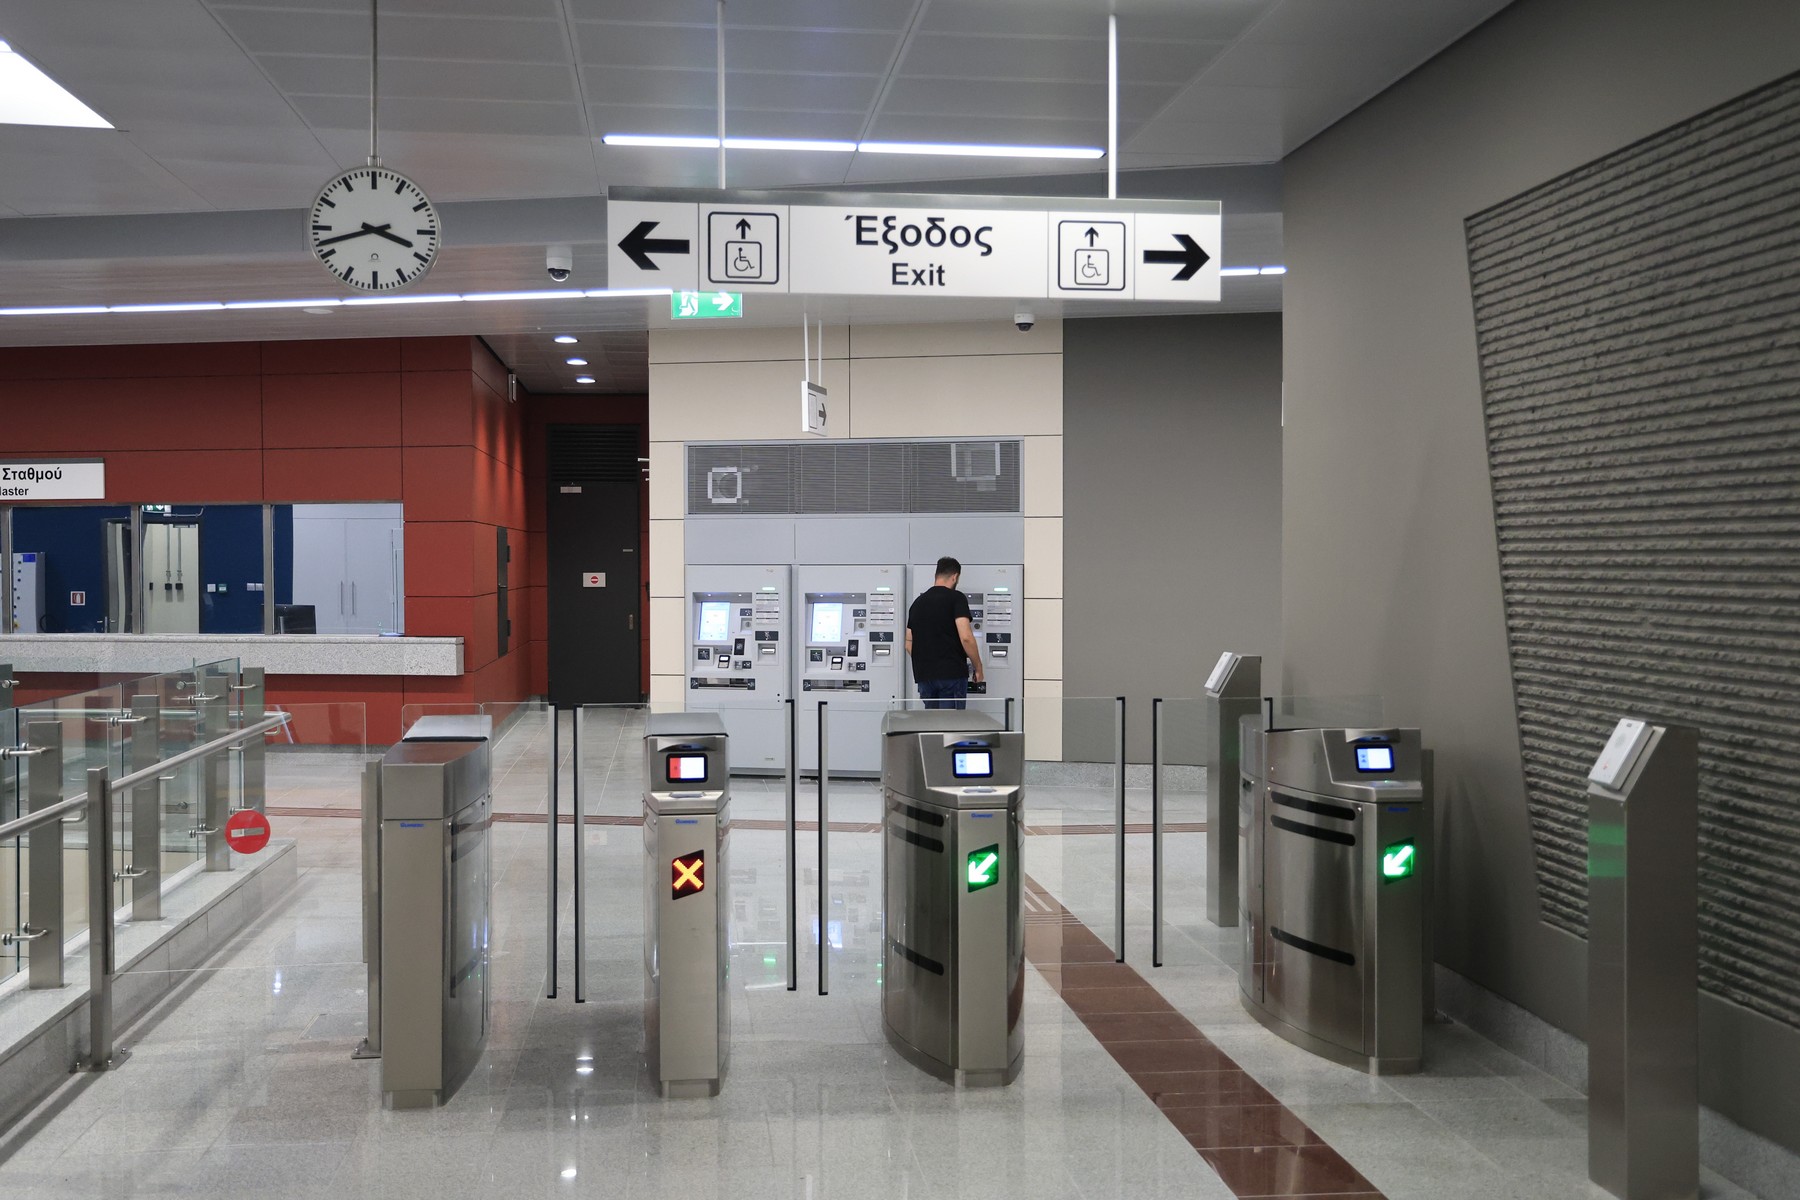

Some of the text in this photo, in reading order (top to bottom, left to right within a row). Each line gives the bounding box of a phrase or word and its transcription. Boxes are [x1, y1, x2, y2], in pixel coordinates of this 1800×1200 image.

[845, 215, 993, 256] Έξοδος
[892, 263, 946, 287] Exit
[2, 467, 62, 484] Σταθμού
[0, 486, 29, 496] aster
